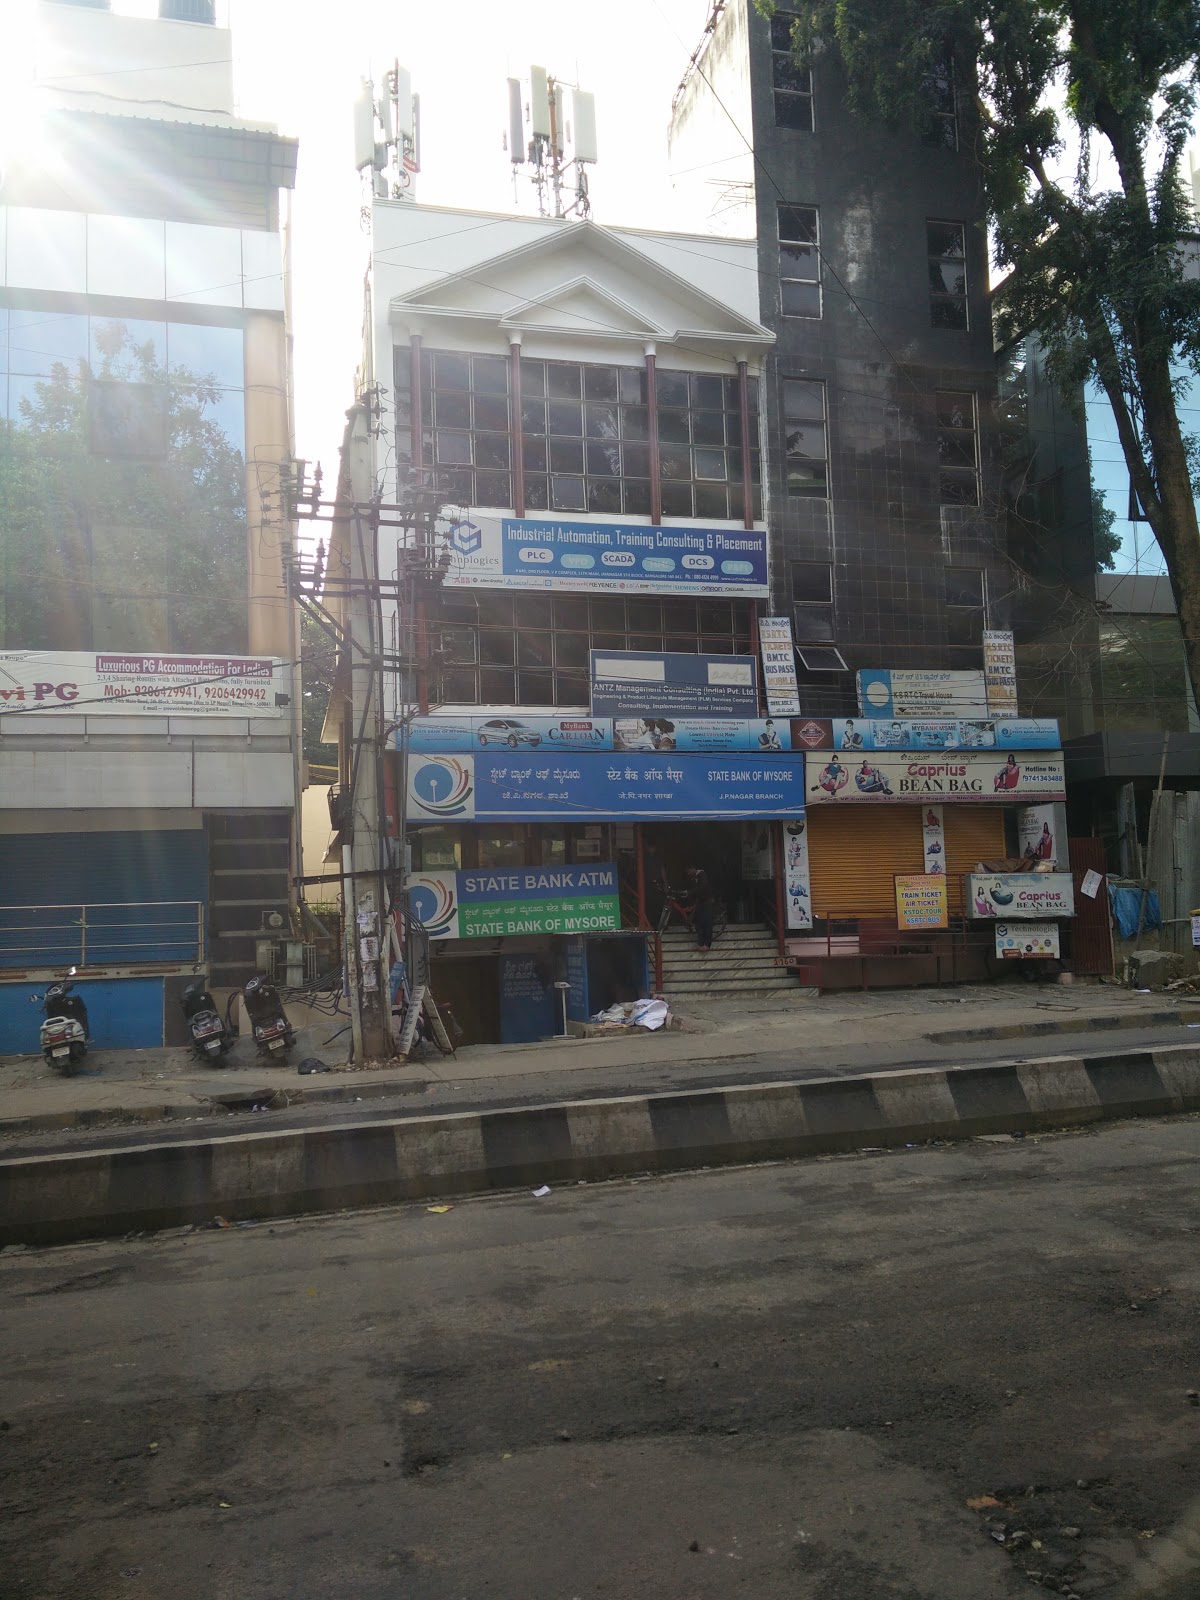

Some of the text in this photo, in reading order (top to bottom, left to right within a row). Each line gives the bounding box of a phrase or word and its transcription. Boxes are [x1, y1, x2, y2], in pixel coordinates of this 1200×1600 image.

[508, 524, 763, 552] Industrial Automation, Training Consulting & Placement
[527, 551, 546, 560] PLC
[603, 554, 634, 563] SCADA
[689, 558, 708, 566] DCS
[987, 654, 1014, 664] TICKETS
[98, 658, 269, 677] Luxurious PG Accommodation For Ladies
[765, 664, 795, 674] BUS PASS
[111, 675, 135, 683] Sharing
[170, 675, 195, 684] Attached
[229, 677, 243, 686] fully
[242, 677, 271, 686] furnished.
[32, 682, 80, 701] PG
[203, 687, 266, 700] 9206429942
[593, 683, 614, 692] ANTZ
[615, 684, 662, 694] Management
[727, 687, 741, 696] Pvt.
[742, 688, 756, 697] Ltd.
[617, 702, 651, 710] Consulting,
[652, 703, 697, 711] Implementation
[710, 704, 733, 713] Training
[562, 722, 591, 730] MyBank
[606, 766, 684, 784] स्टेट बैंक ऑफ मैसूर
[707, 771, 793, 781] STATE BANK OF MYSORE
[907, 762, 967, 780] Caprius
[899, 778, 983, 792] BEAN BAG
[465, 871, 613, 892] STATE BANK ATM
[1018, 890, 1062, 903] Caprius
[466, 915, 615, 935] STATE BANK OF MYSORE
[1009, 925, 1058, 934] Technologics
